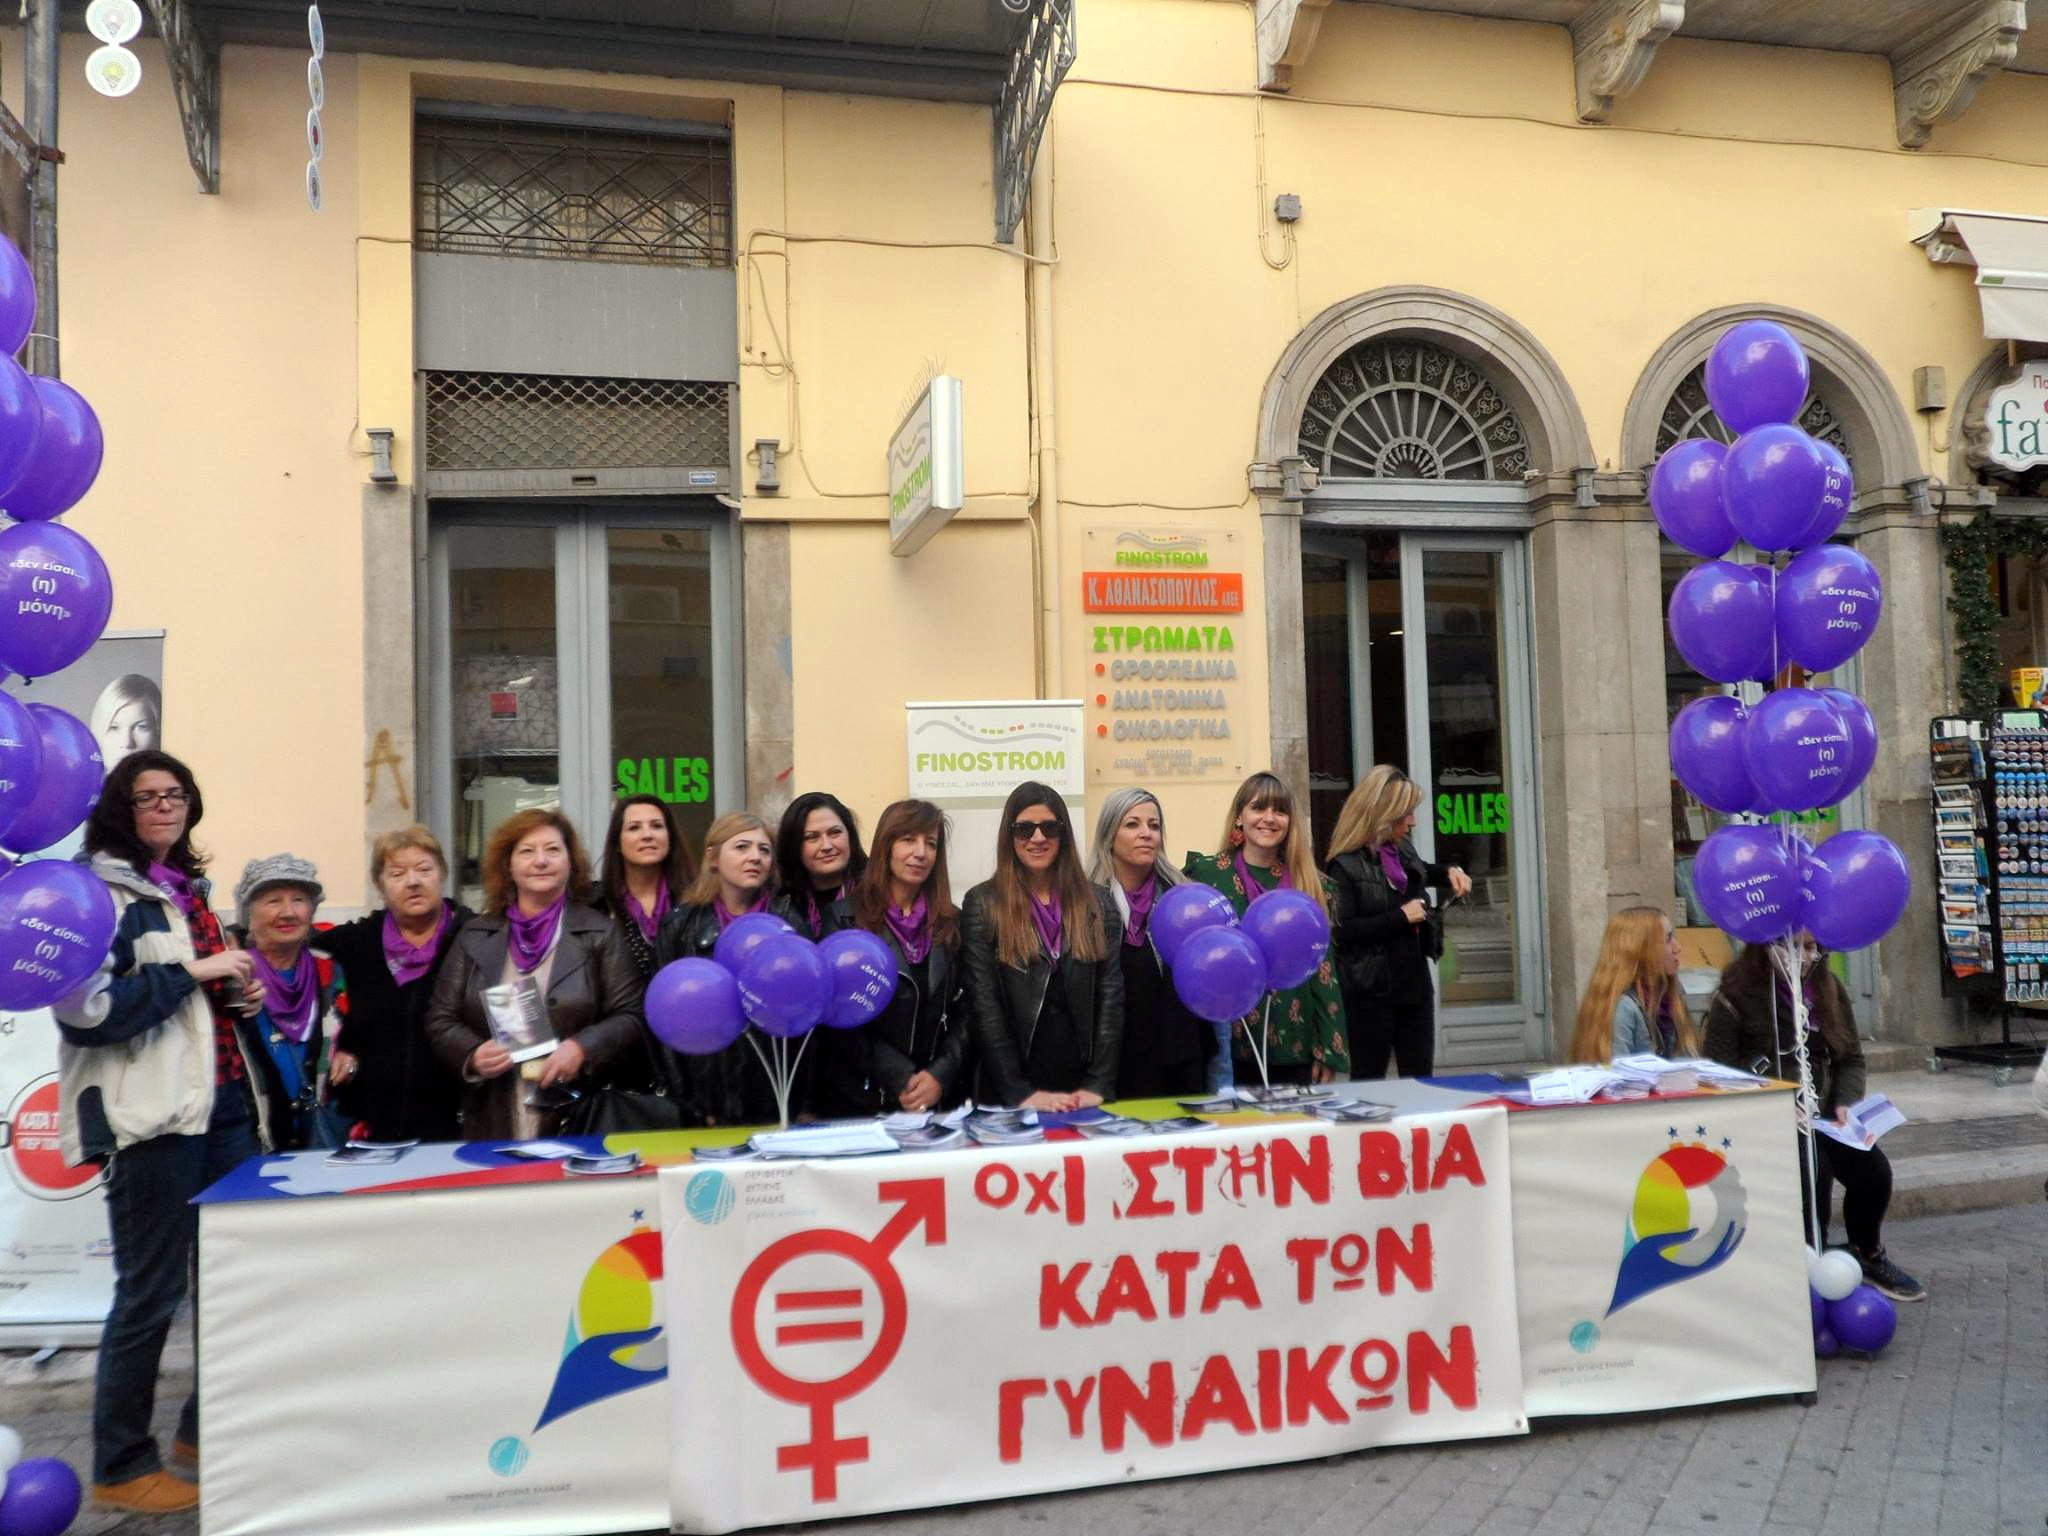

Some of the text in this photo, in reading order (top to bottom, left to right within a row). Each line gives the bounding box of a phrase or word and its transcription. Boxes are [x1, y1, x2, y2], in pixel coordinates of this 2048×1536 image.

[1115, 551, 1209, 567] FINOSTROM
[31, 575, 57, 595] (η)
[1088, 577, 1102, 606] Κ.
[1105, 577, 1218, 607] ΑΘΑΝΑΣΟΠΟΥΛΟΣ
[18, 598, 71, 620] μόνη»
[1839, 600, 1857, 615] (η)
[1093, 626, 1234, 652] ΣΤΡΩΜΑΤΑ
[1111, 659, 1237, 681] ΟΡΘΟΠΕΔΙΚΑ
[1111, 689, 1227, 711] ΑΝΑΤΟΜΙΚΑ
[1113, 719, 1231, 741] ΟΙΚΟΛΟΓΙΚΑ
[916, 751, 1066, 773] FINOSTROM
[1819, 747, 1834, 762] (η)
[616, 758, 710, 804] SALES
[1437, 793, 1512, 834] SALES
[1746, 889, 1765, 904] (η)
[35, 940, 62, 960] (η)
[865, 980, 881, 996] (η)
[974, 1123, 1487, 1225] ΟΧΙ ΣΤΗΝ ΒΙΑ
[1039, 1223, 1434, 1329] ΚΑΤΑ ΤΩΝ
[999, 1325, 1478, 1463] ΓΥΝΑΙΚΩΝ
